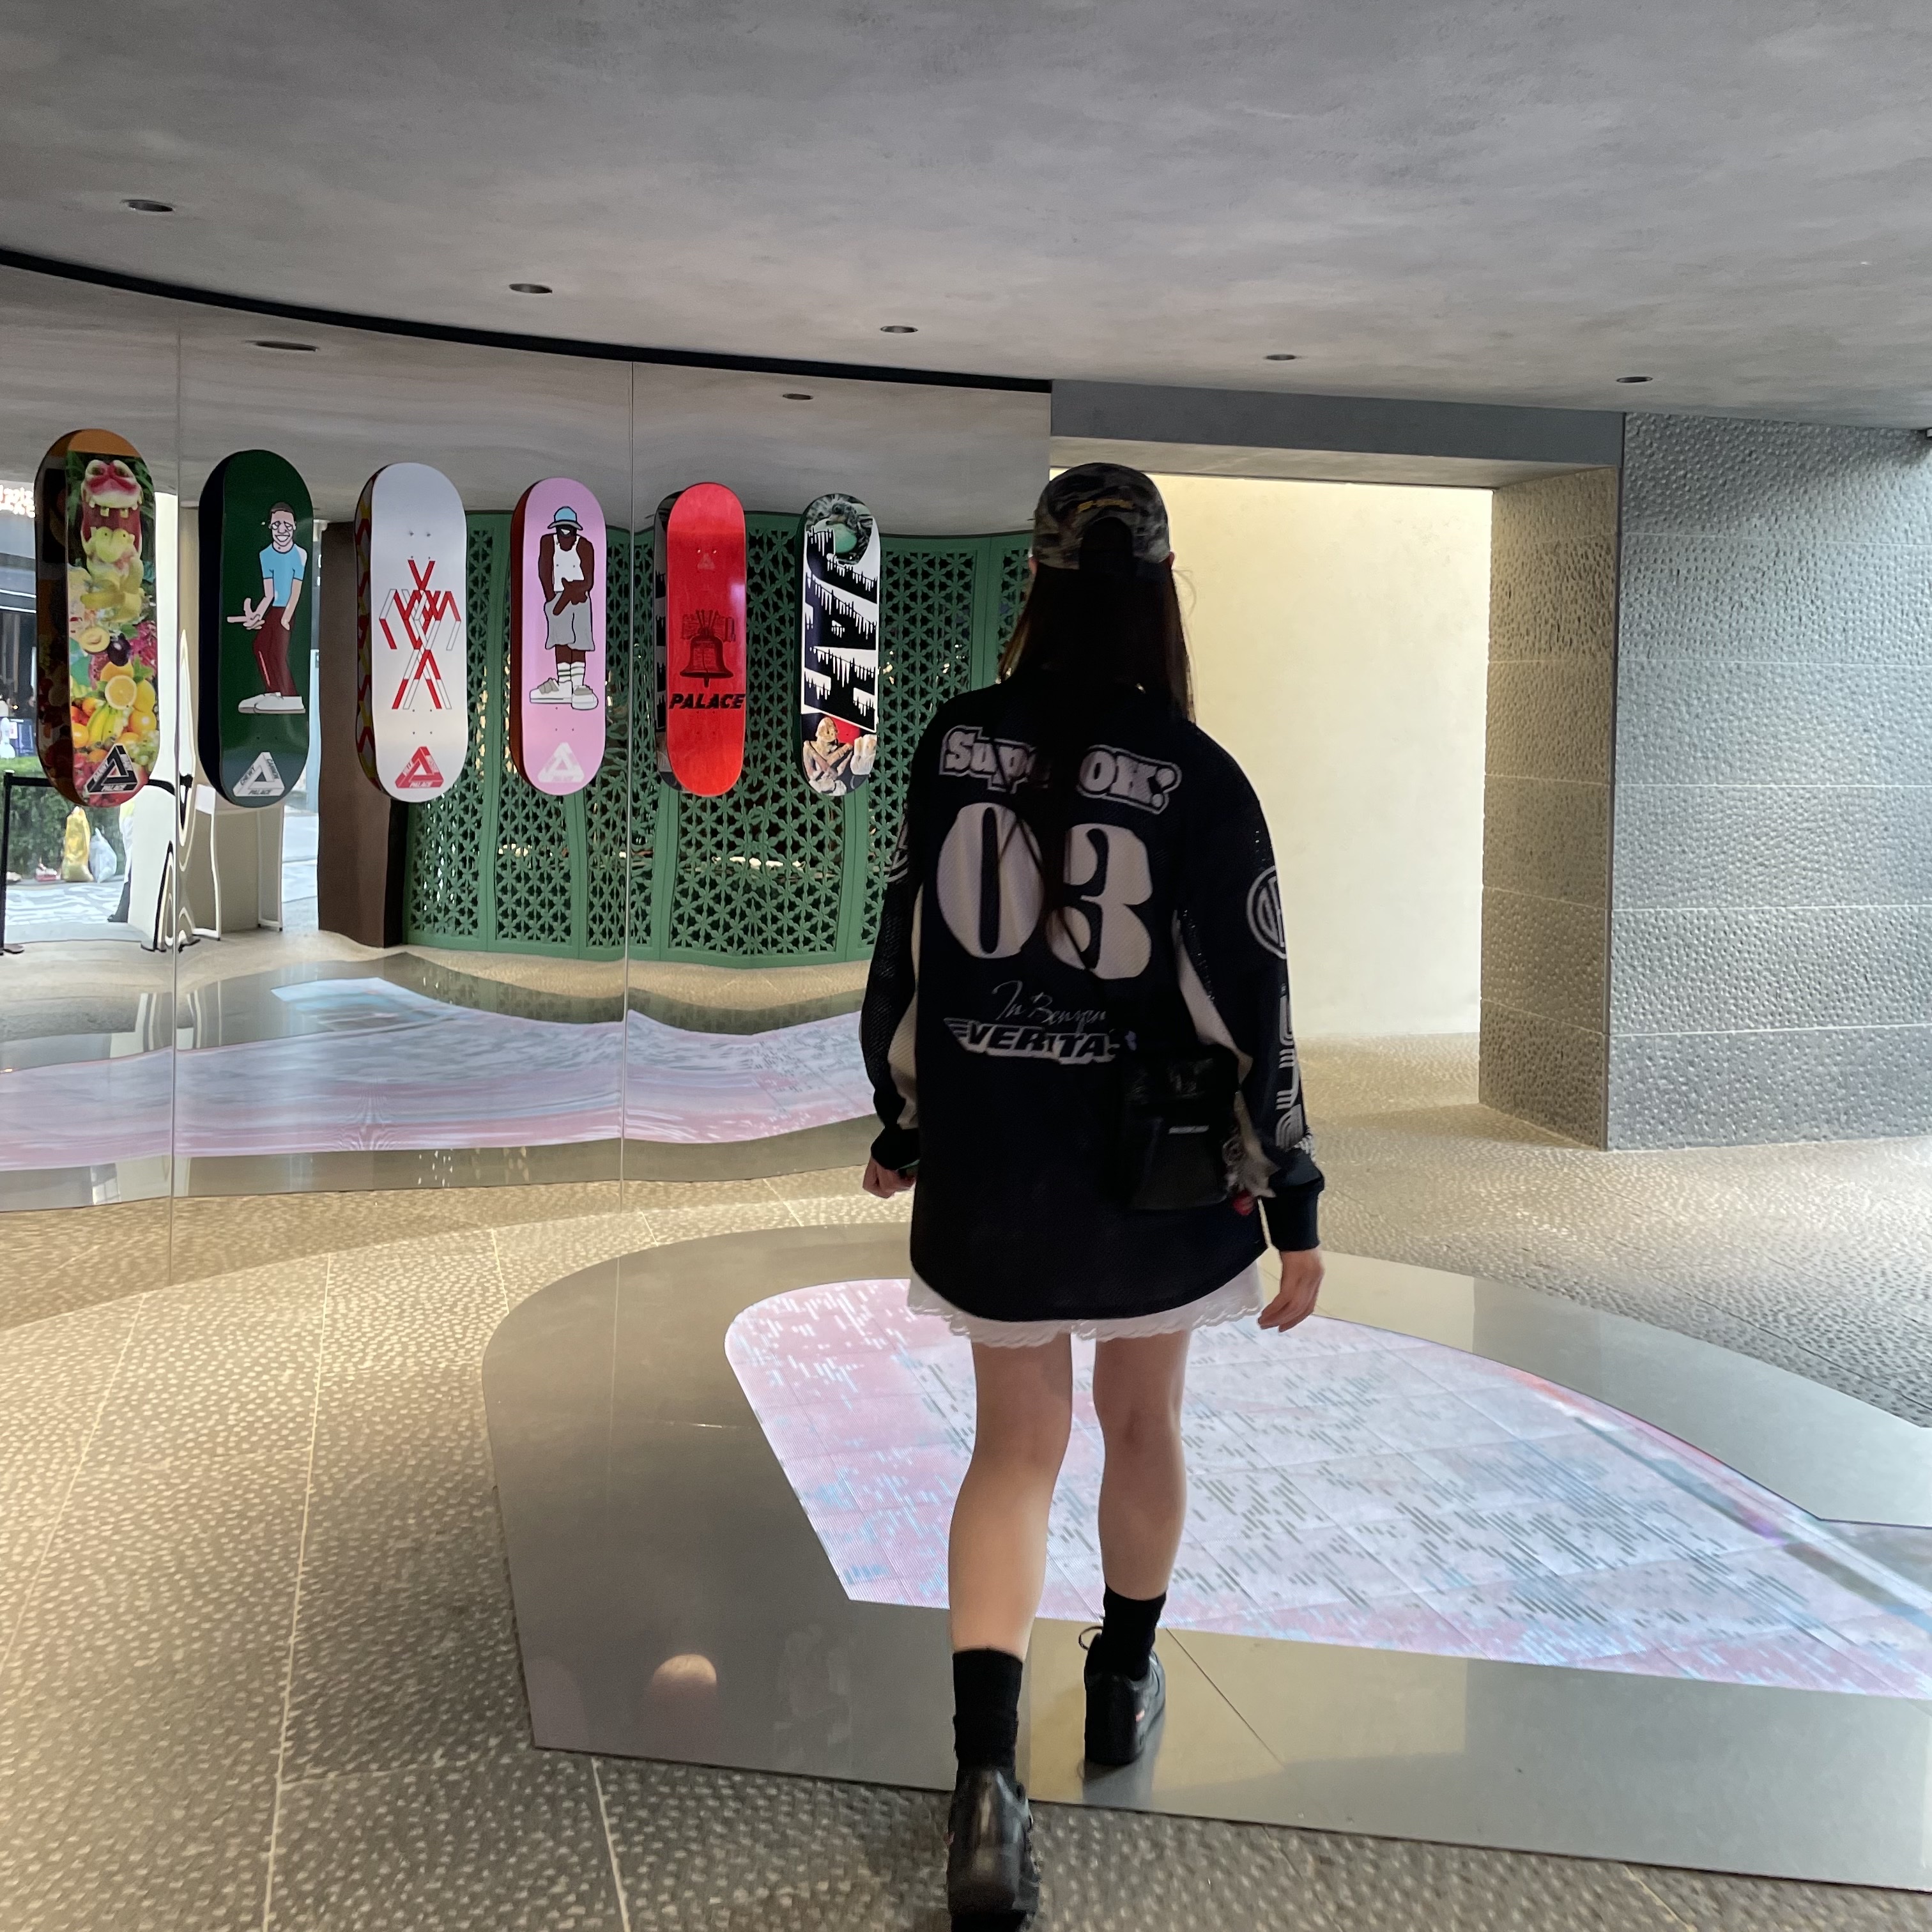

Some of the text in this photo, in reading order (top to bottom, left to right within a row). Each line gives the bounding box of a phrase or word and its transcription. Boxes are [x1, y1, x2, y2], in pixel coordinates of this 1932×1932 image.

[668, 693, 746, 710] PALACE
[942, 728, 1052, 792] Sup
[936, 801, 1154, 979] 03
